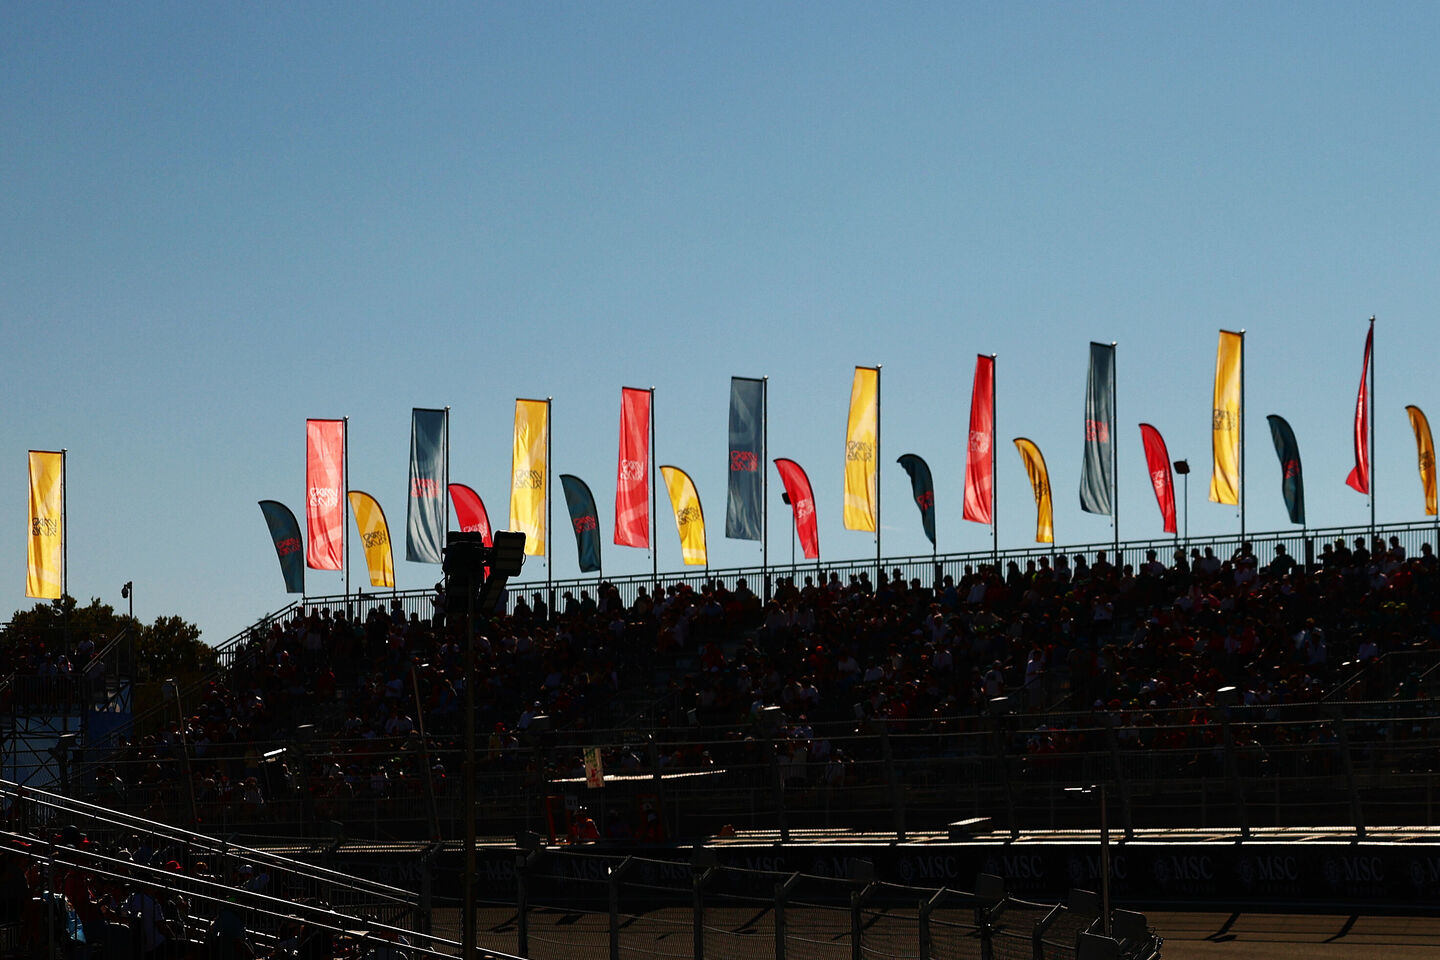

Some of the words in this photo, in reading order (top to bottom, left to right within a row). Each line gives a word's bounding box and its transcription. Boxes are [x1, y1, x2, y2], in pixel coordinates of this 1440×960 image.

[919, 855, 960, 880] MSC
[1001, 855, 1044, 880] MSC
[1171, 855, 1215, 881] MSC
[1255, 855, 1298, 881] MSC
[1341, 856, 1385, 881] MSC
